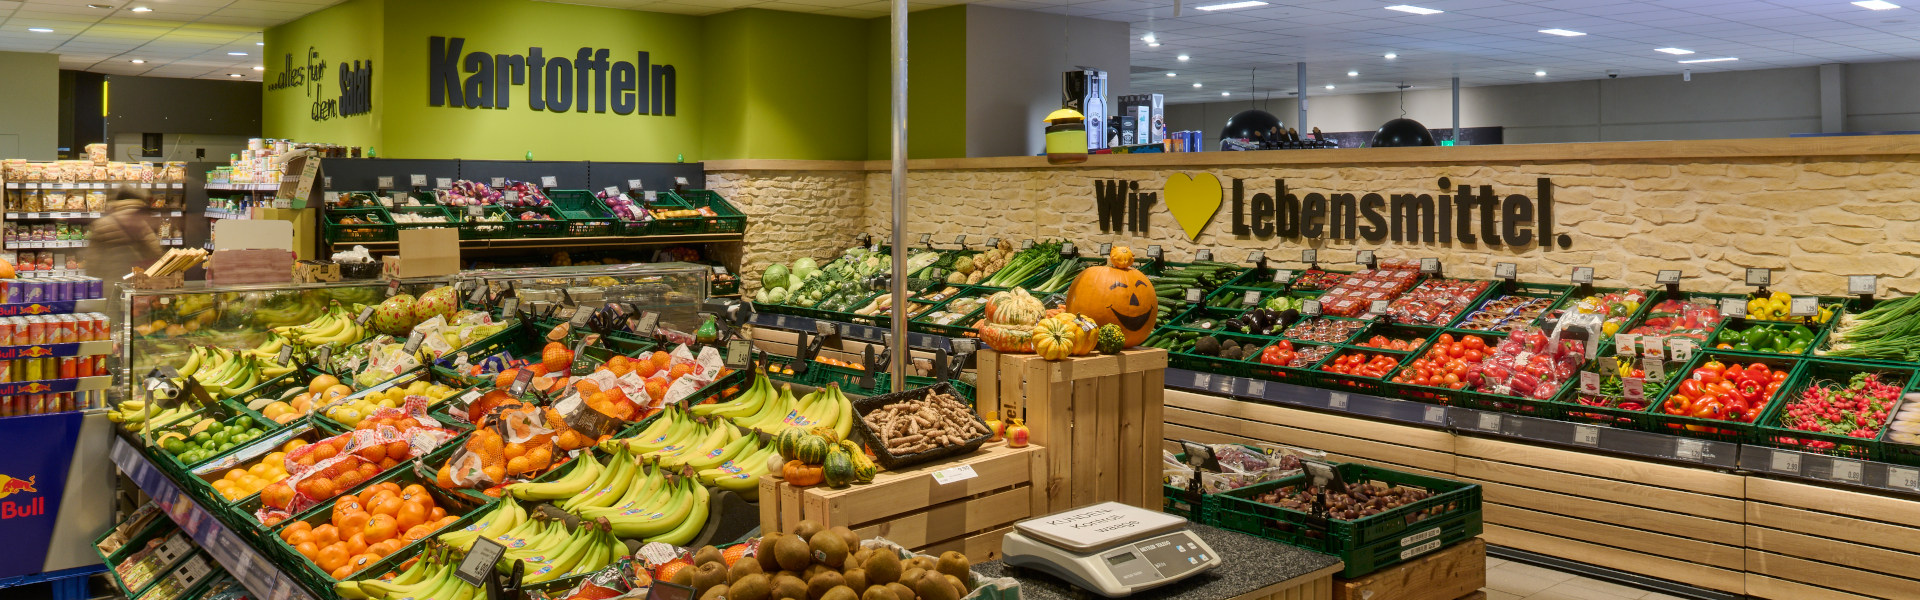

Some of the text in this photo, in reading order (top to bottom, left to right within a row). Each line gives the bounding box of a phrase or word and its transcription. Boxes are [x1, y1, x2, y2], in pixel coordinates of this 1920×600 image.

[307, 46, 327, 97] für
[311, 60, 372, 122] den Salat
[429, 36, 677, 116] Kartoffeln
[1094, 176, 1573, 249] Wir Lebensmittel.
[0, 306, 17, 315] Bull
[1, 496, 45, 520] Bull
